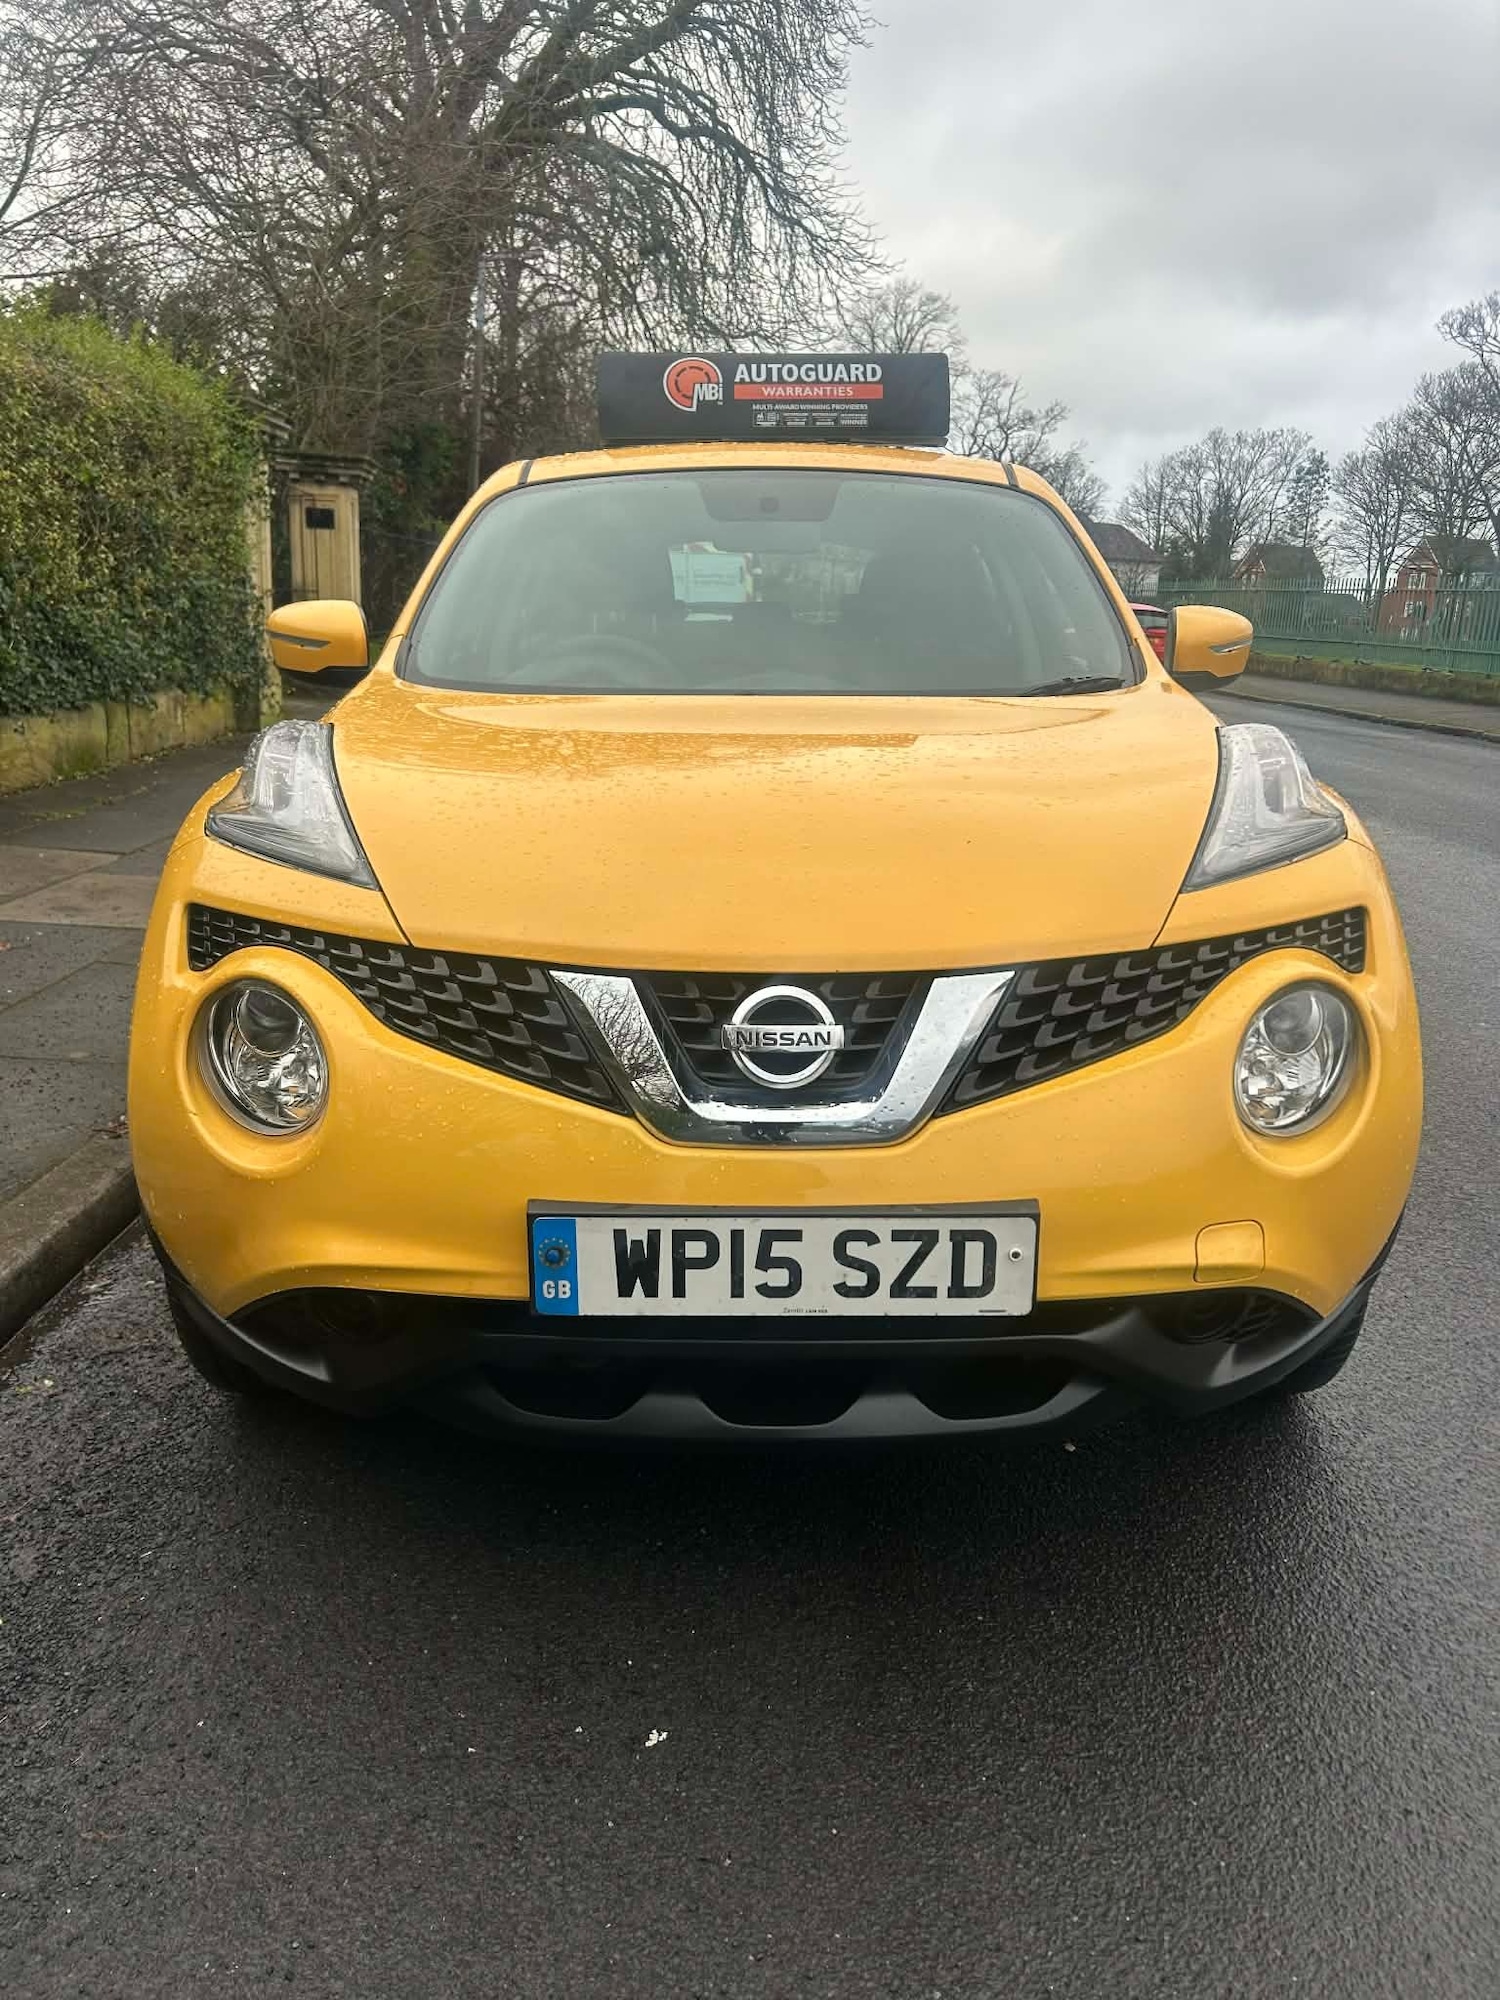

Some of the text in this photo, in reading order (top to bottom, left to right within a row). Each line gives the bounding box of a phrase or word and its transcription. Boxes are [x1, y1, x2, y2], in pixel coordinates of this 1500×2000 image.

[734, 363, 882, 382] AUTOGUARD
[762, 386, 854, 396] WARRANTIES
[736, 1031, 831, 1046] NISSAN
[613, 1229, 998, 1299] WP15 SZD
[543, 1280, 571, 1298] GB
